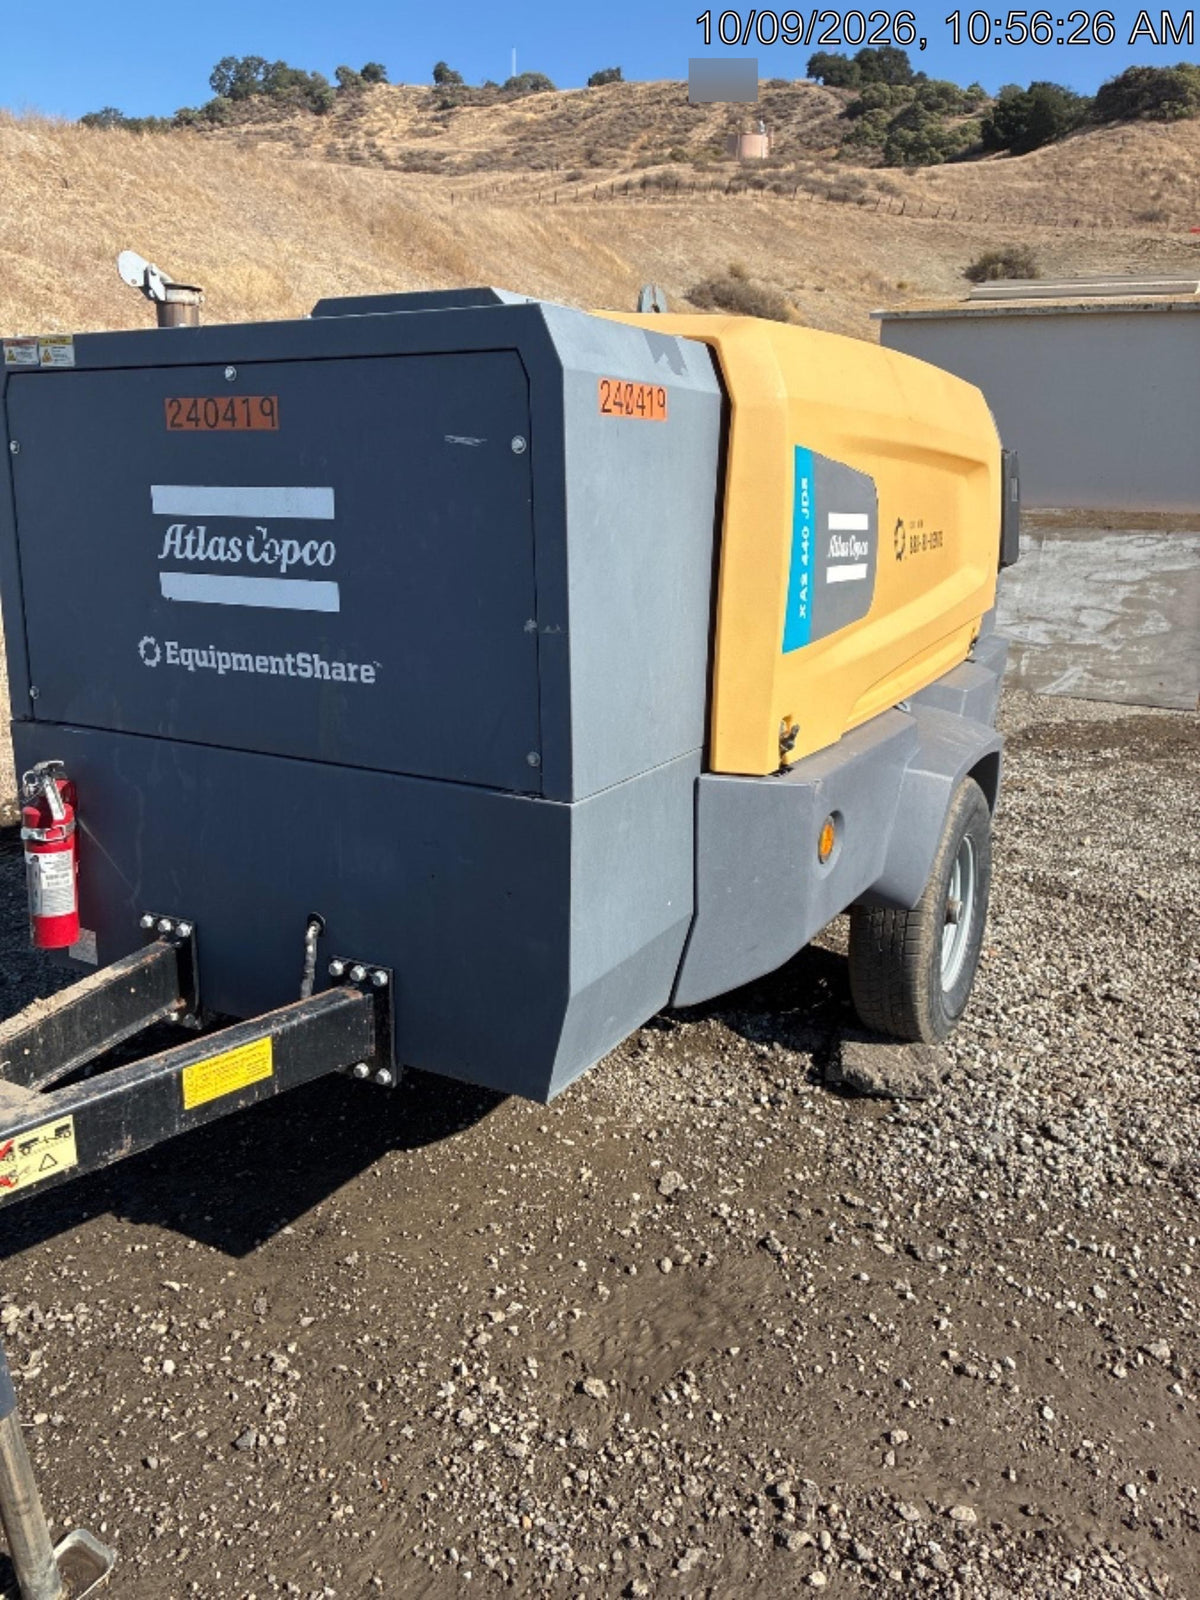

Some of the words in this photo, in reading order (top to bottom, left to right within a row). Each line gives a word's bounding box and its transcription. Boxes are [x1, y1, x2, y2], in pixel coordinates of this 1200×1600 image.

[168, 396, 277, 428] 240419
[600, 380, 666, 419] 240419
[158, 524, 242, 561] Atlas
[802, 526, 810, 567] 440
[165, 641, 376, 684] EquipmentShare
